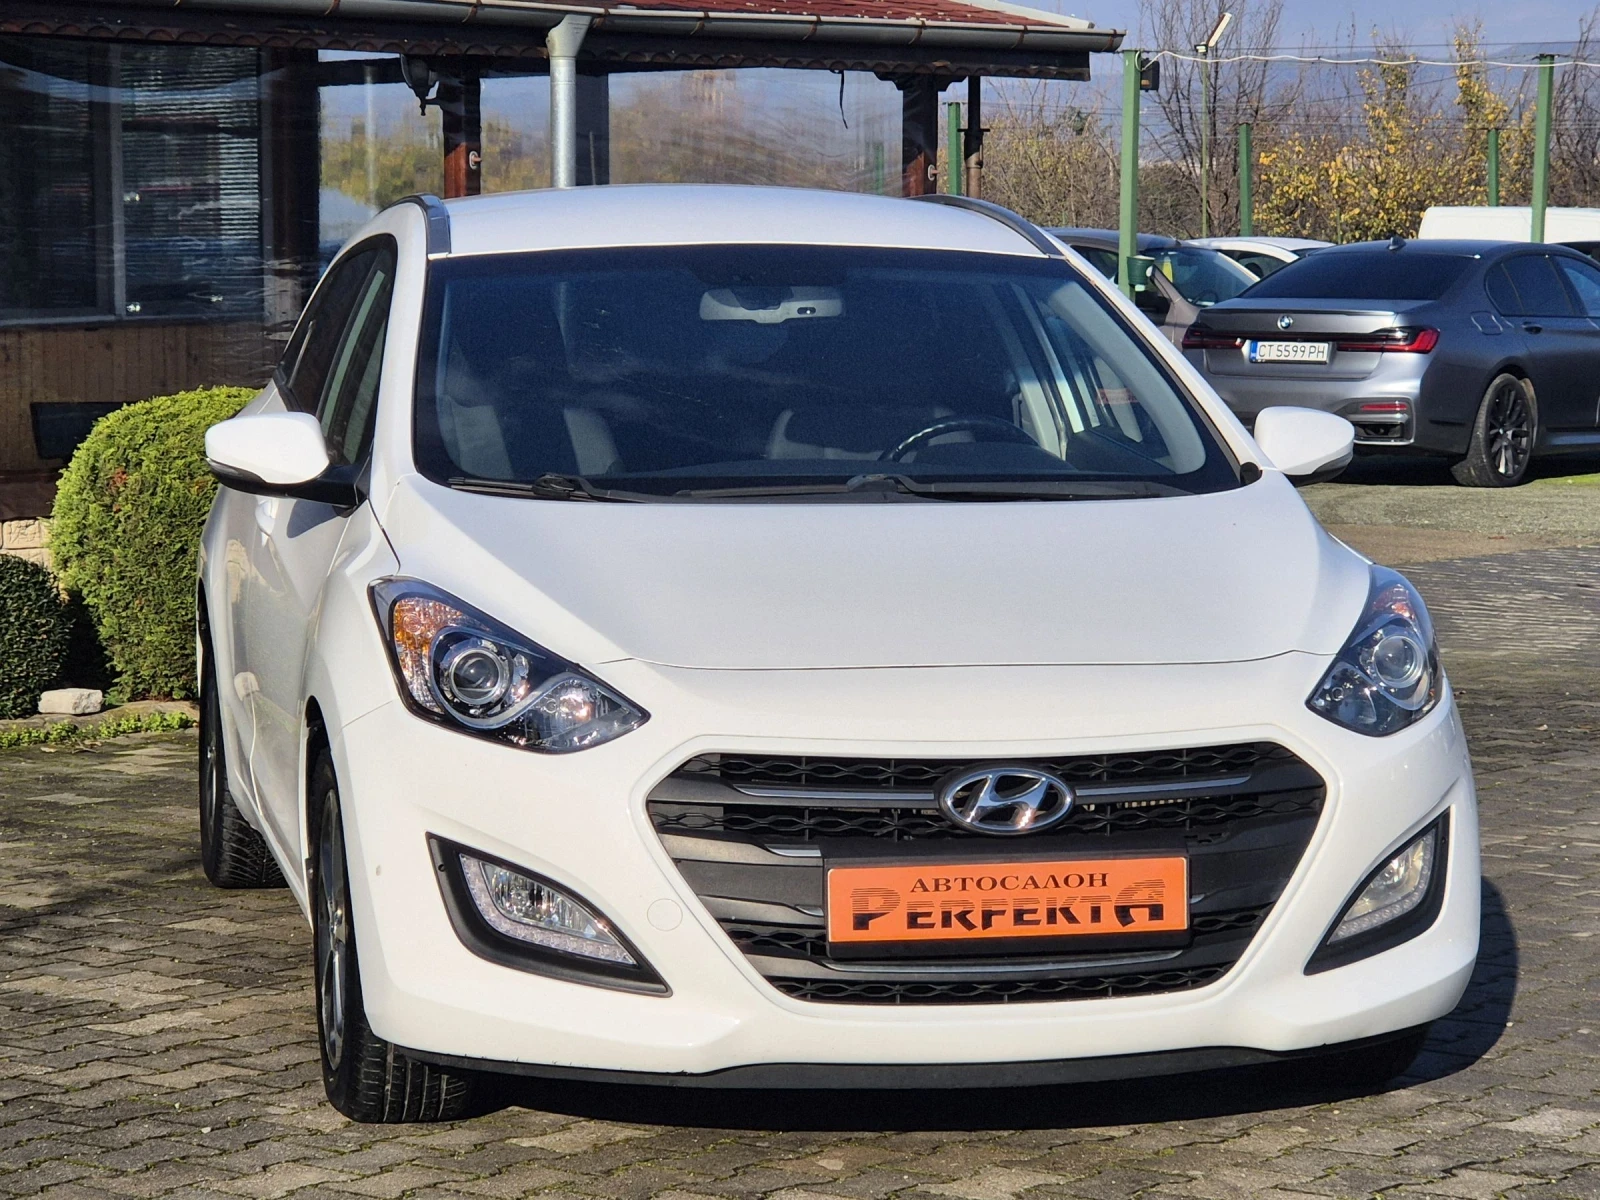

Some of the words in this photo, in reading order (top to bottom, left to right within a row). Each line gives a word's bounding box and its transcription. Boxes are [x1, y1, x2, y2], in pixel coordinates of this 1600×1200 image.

[1258, 344, 1275, 358] CT
[1276, 344, 1306, 358] 5599
[1308, 345, 1326, 358] PH
[910, 872, 1109, 893] АВТОСАЛОН
[850, 878, 1166, 932] PERFEKTA
